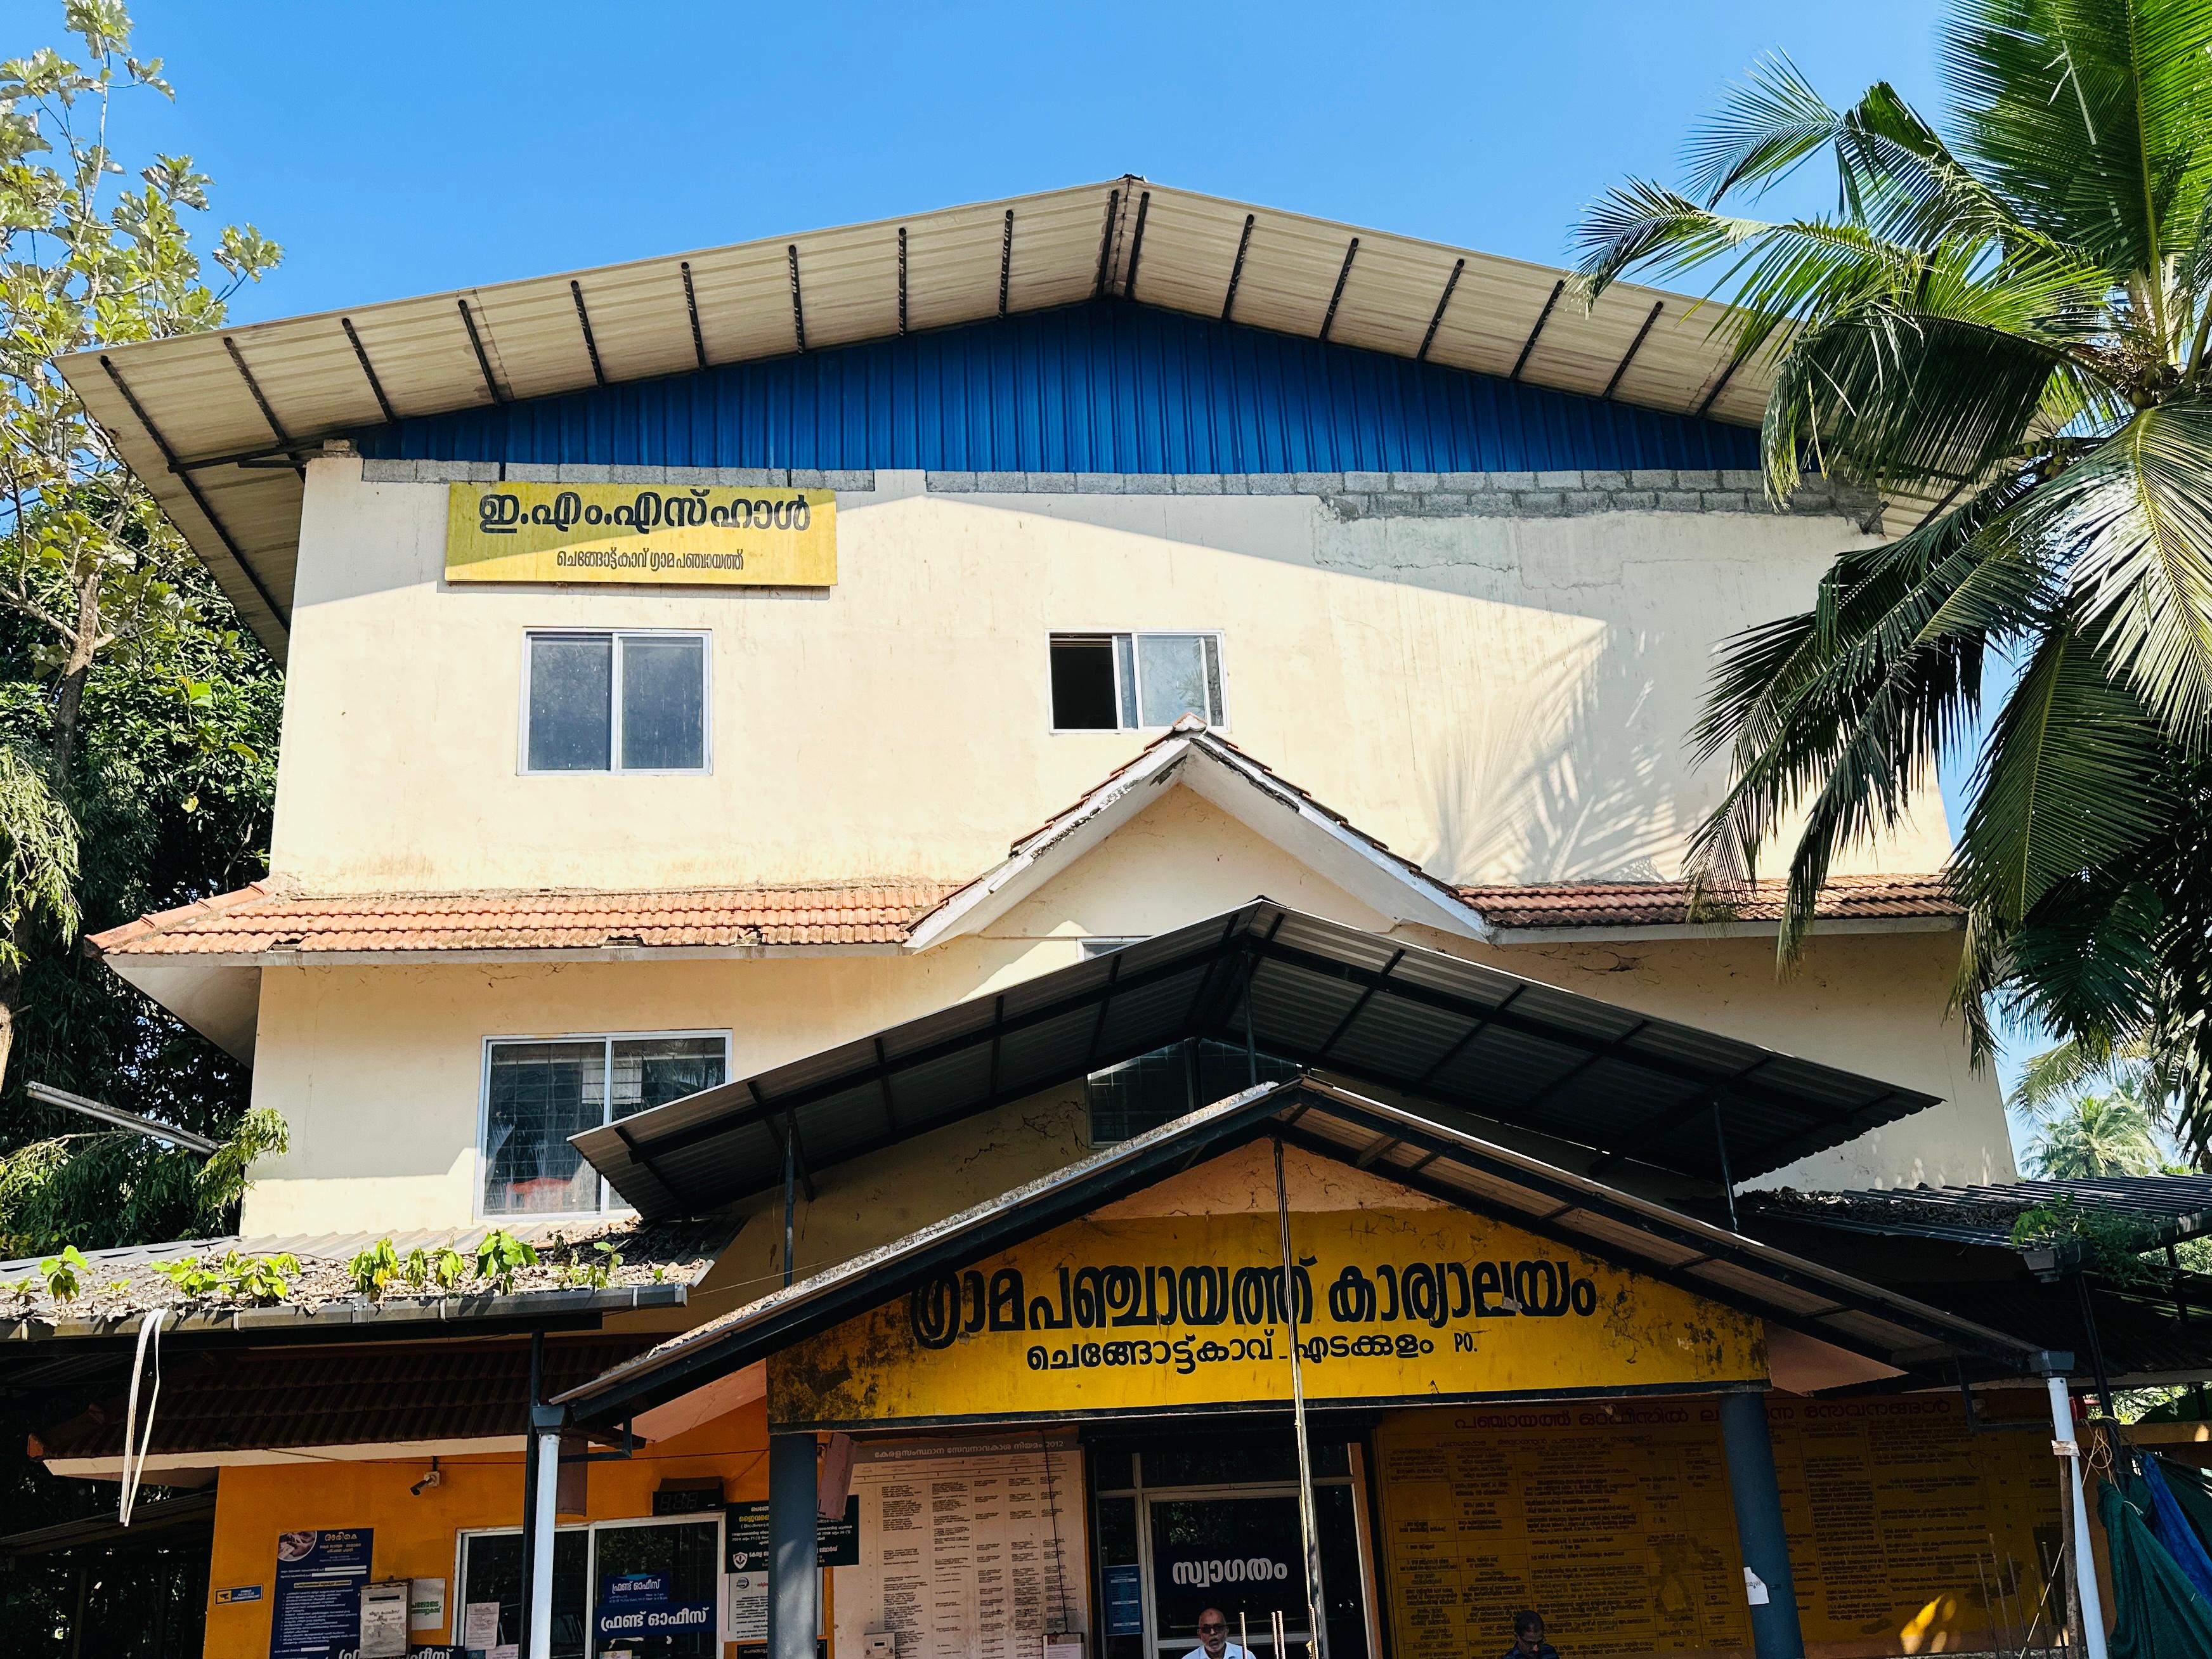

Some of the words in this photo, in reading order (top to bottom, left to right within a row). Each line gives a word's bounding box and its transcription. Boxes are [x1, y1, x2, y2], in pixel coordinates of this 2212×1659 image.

[1329, 1260, 1597, 1329] കാര്യാലയം
[1298, 1332, 1434, 1363] എടക്കുളം
[1046, 1440, 1064, 1448] 2012
[1172, 1558, 1288, 1587] സ്വാഗതം
[601, 1611, 647, 1632] ഫ്രണ്ട്
[648, 1606, 710, 1627] ഓഫീസ്
